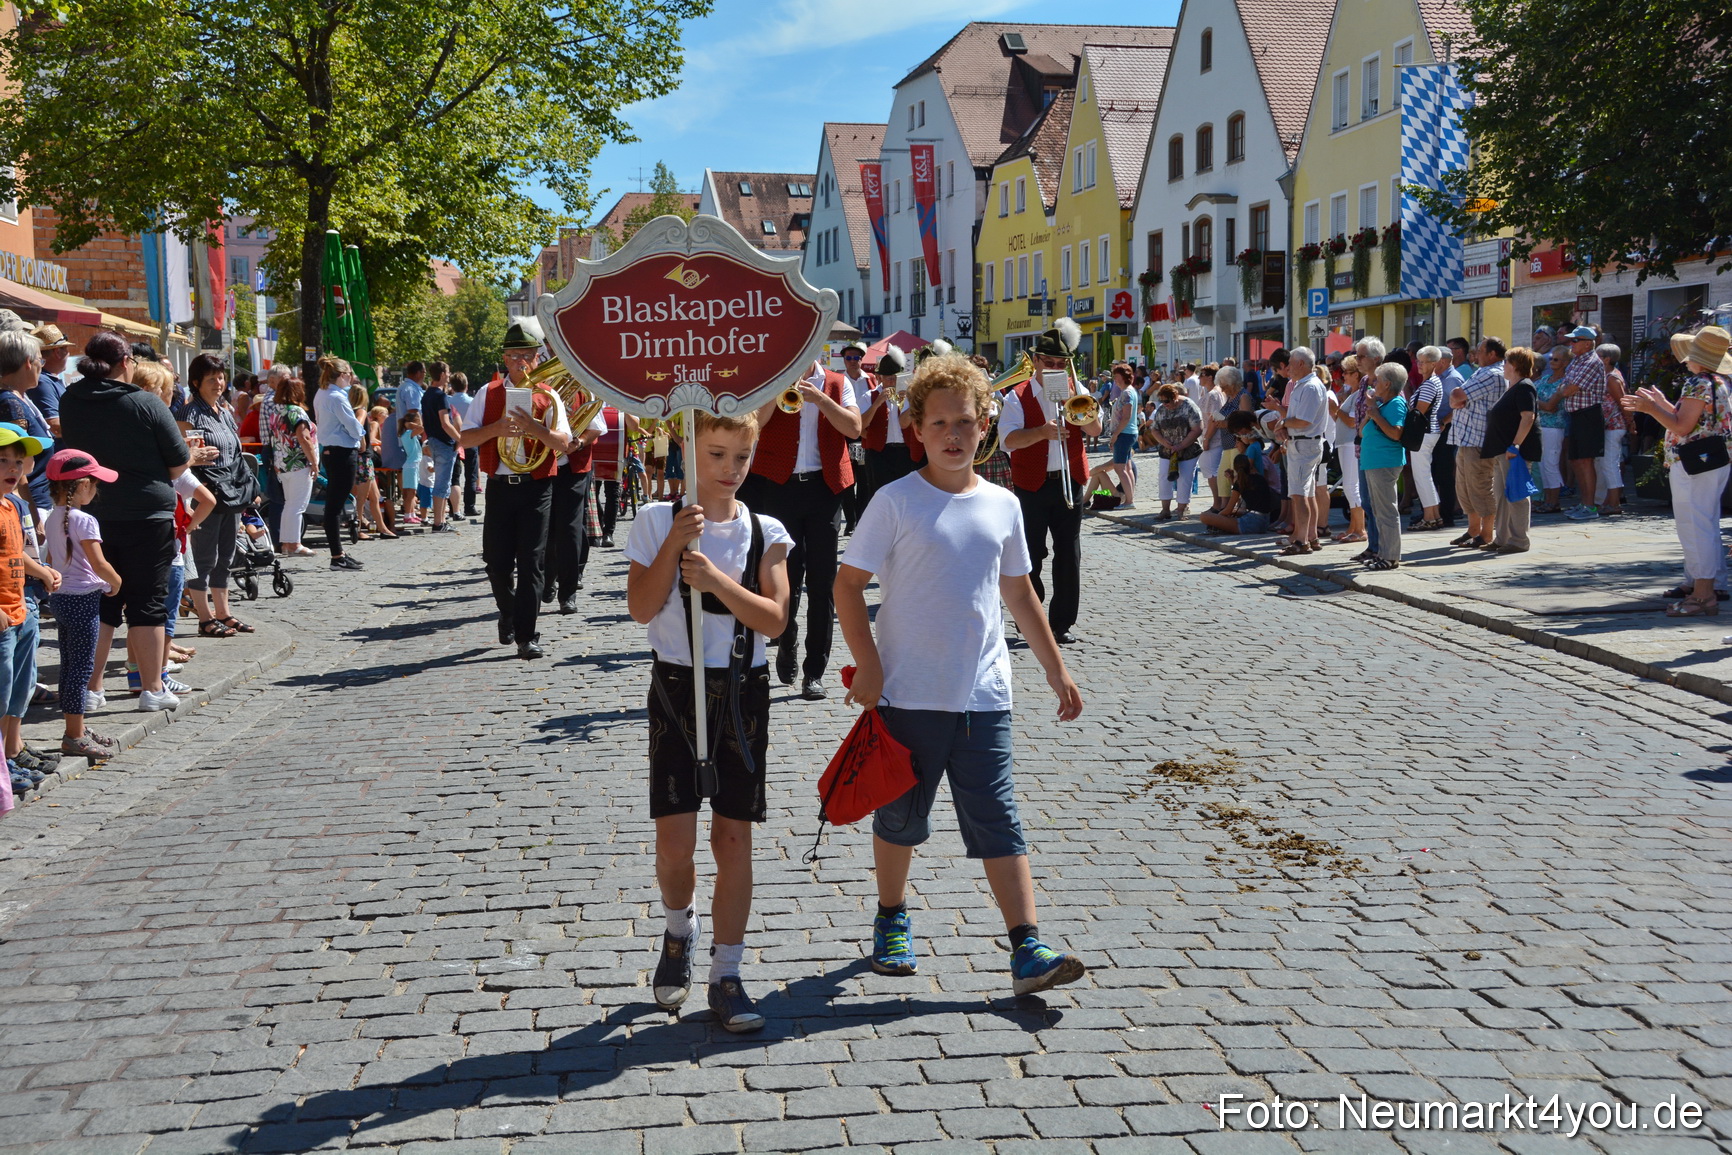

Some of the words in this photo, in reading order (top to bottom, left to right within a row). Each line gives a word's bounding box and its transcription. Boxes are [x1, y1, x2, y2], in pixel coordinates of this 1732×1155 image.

[915, 149, 928, 182] K&L
[1008, 234, 1026, 252] HOTEL
[1030, 230, 1051, 246] Lehmeier
[601, 289, 783, 327] Blaskapelle
[1312, 291, 1324, 314] P
[1006, 318, 1032, 330] Restaurant
[619, 326, 769, 360] Dirnhofer
[673, 362, 713, 384] Stauf
